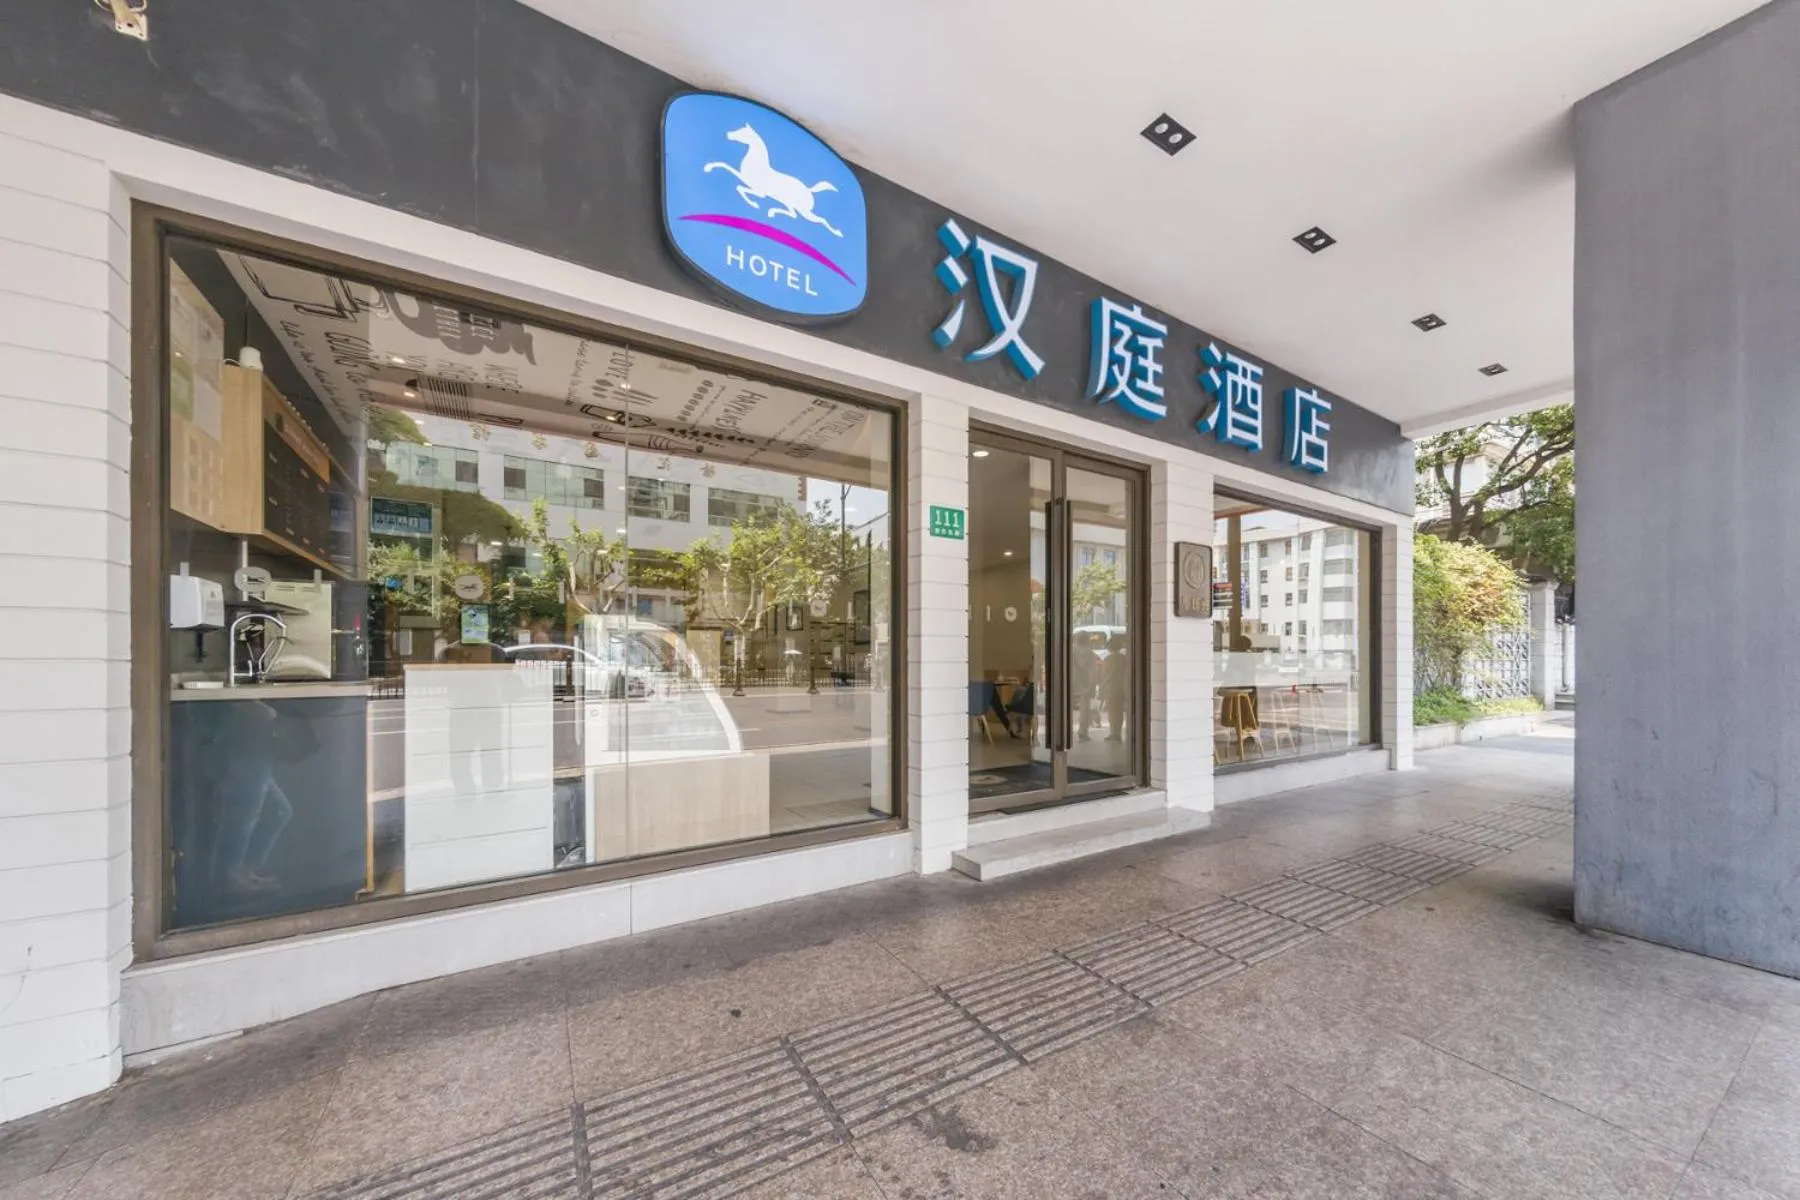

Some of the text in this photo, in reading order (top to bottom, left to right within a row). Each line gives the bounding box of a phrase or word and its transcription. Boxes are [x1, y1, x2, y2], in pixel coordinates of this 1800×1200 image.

[726, 244, 818, 296] HOTEL
[931, 217, 1333, 475] 汉庭酒店
[935, 509, 960, 528] 111
